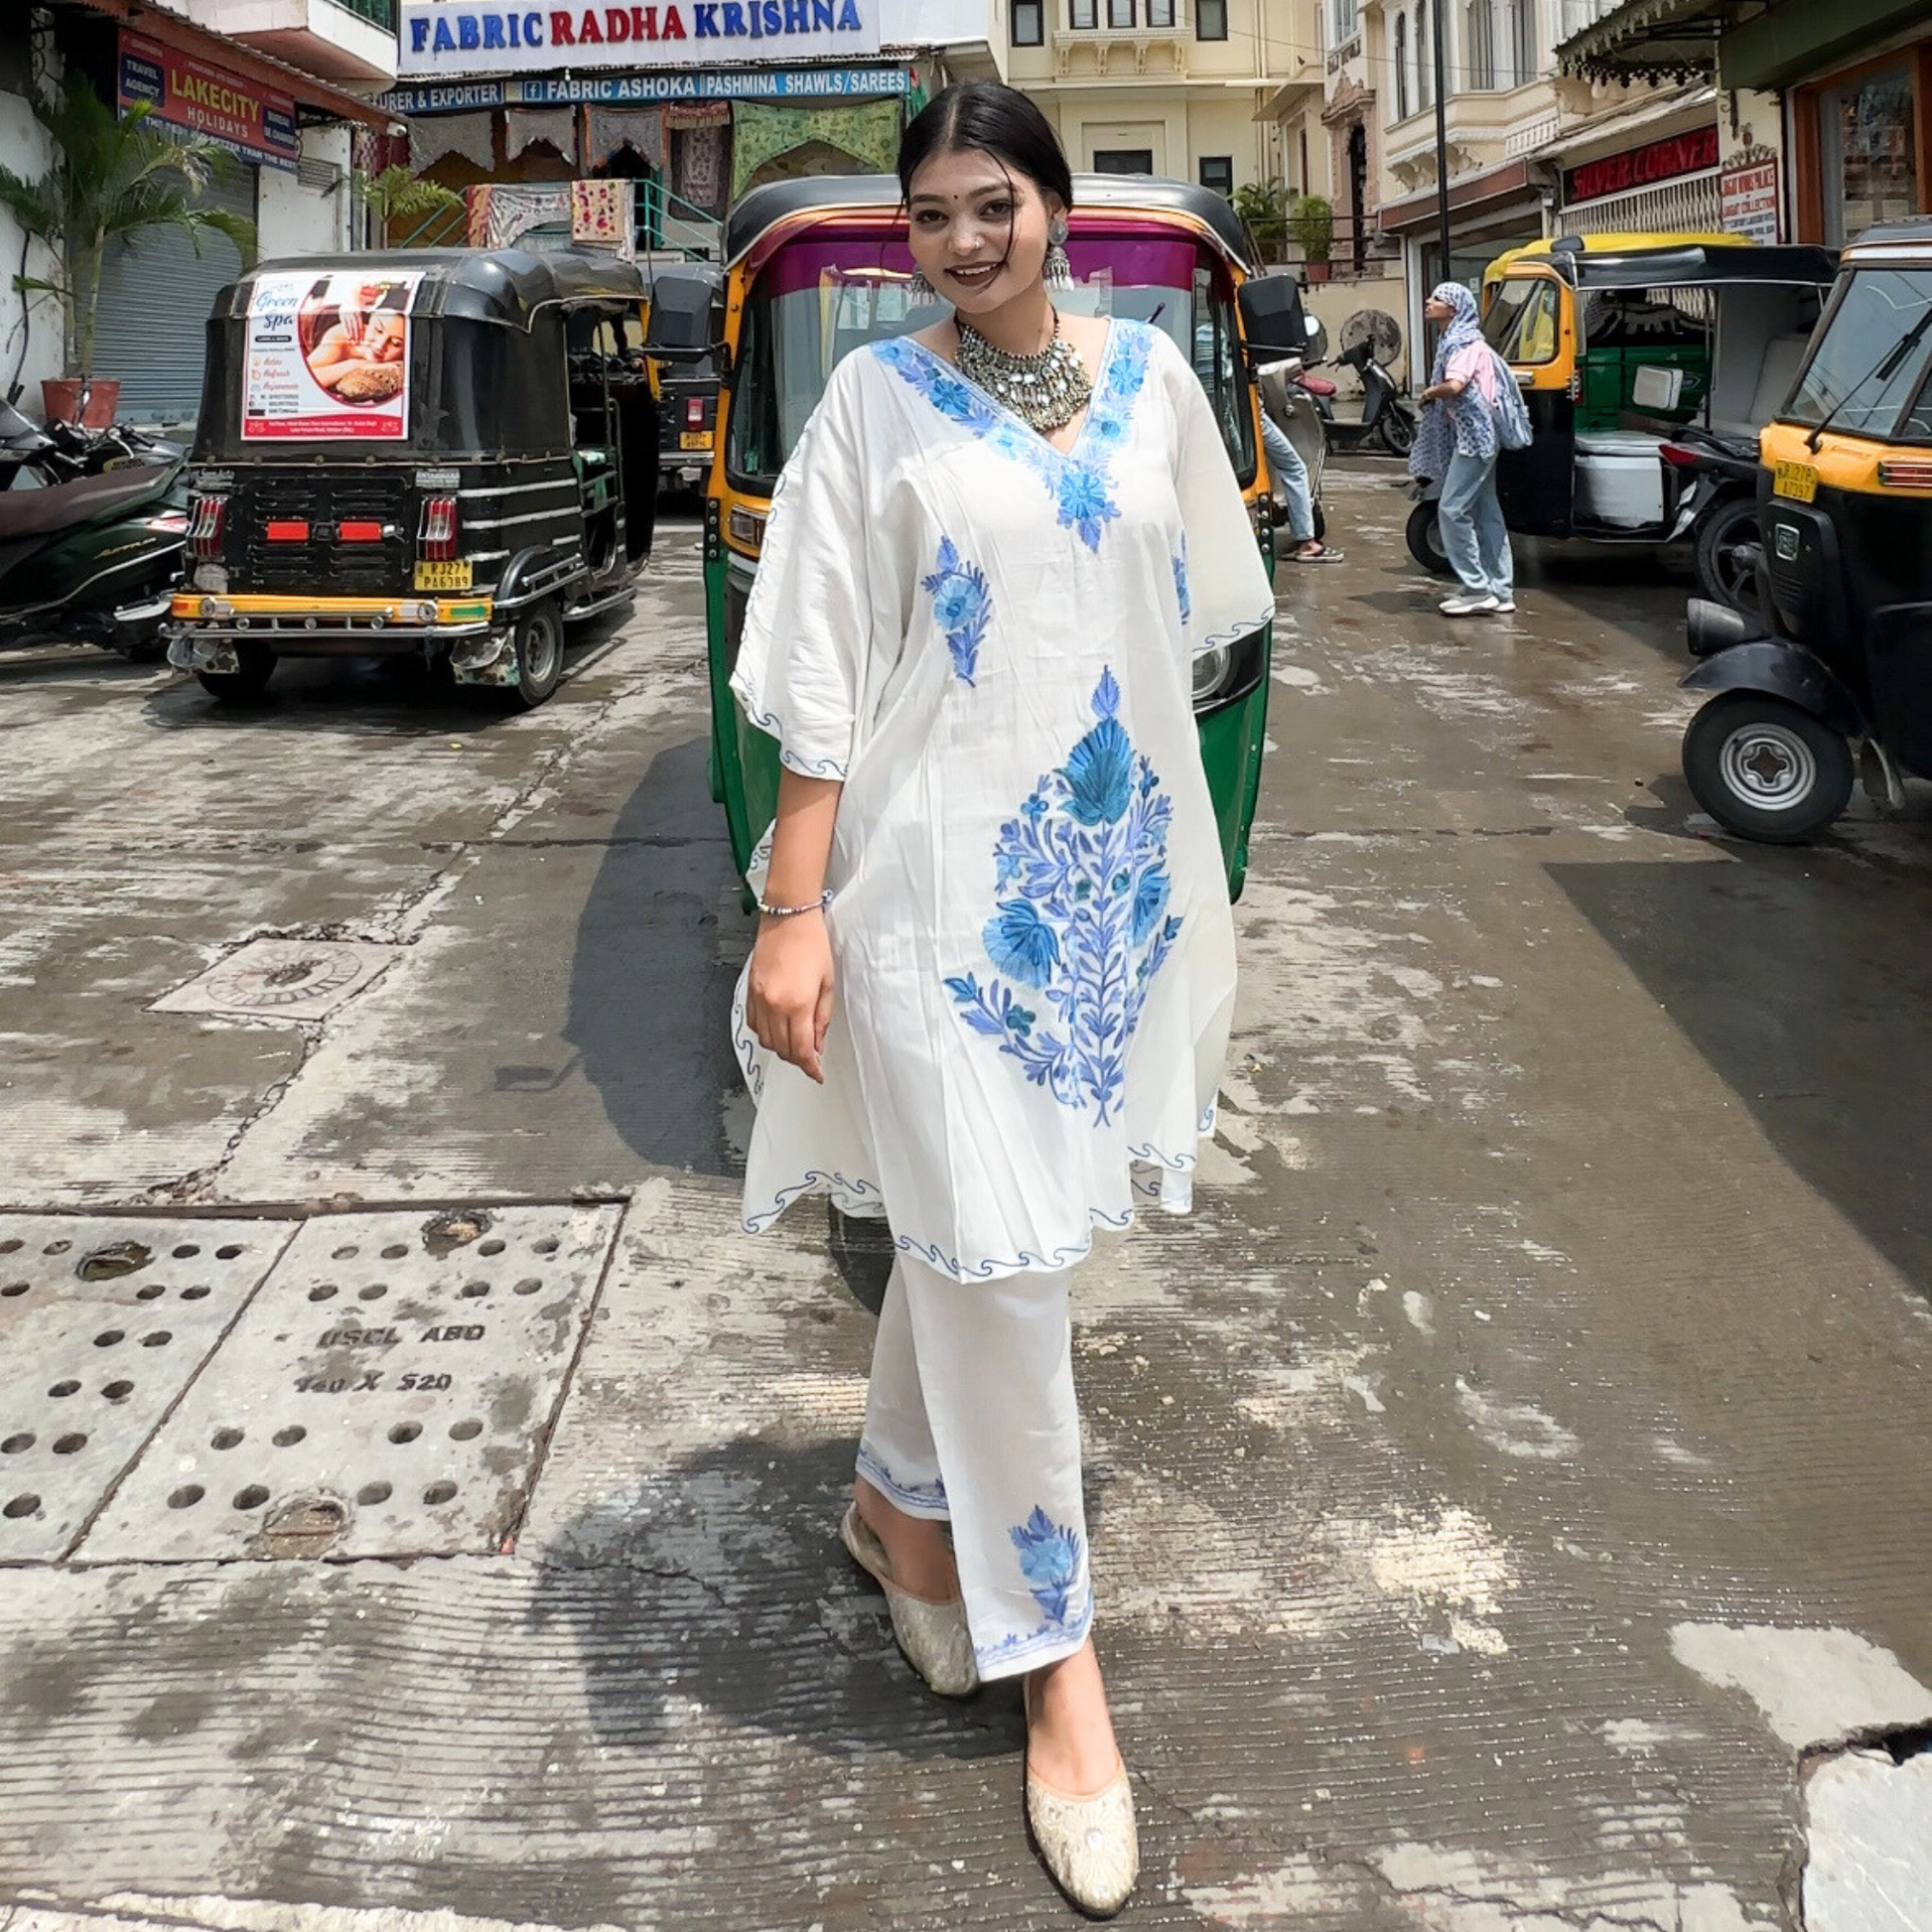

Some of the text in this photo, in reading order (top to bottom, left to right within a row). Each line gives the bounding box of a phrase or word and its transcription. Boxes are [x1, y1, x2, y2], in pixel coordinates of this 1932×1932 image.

[409, 0, 862, 52] FABRIC RADHA KRISHNA
[126, 60, 159, 80] TRAVEL
[706, 69, 905, 95] PASHMINA SHAWLS/SAREES
[125, 77, 160, 97] AGENCY
[171, 69, 260, 123] LAKECITY
[371, 90, 415, 112] URER
[431, 83, 498, 107] EXPORTER
[547, 78, 613, 99] FABRIC
[617, 74, 695, 98] ASHOKA
[187, 105, 248, 138] HOLIDAYS
[256, 290, 299, 311] Green
[396, 1373, 452, 1392] 520
